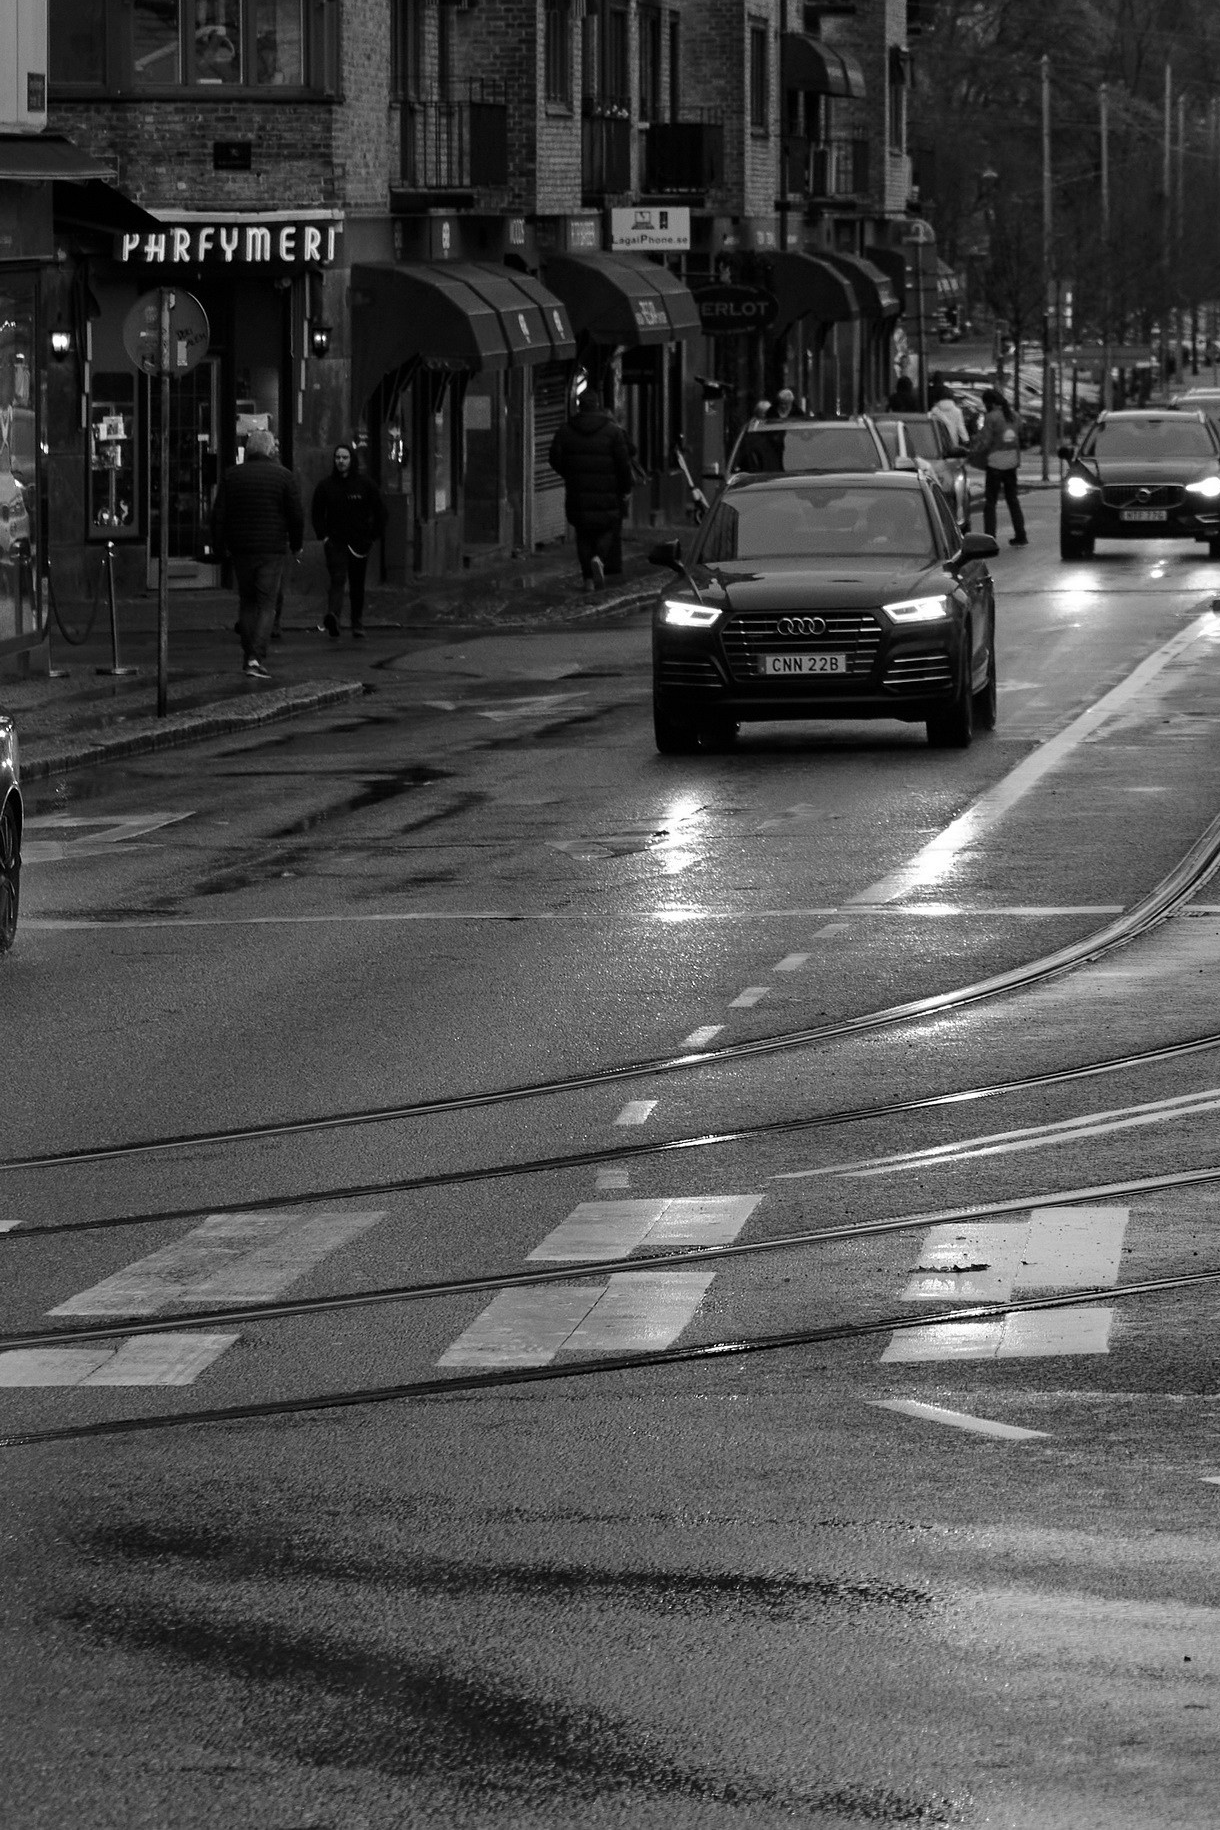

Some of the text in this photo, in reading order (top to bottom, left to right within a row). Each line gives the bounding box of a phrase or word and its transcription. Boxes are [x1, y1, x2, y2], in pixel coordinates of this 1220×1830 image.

[121, 226, 335, 263] PARFYMERI
[699, 301, 769, 317] ERLOT
[772, 657, 839, 672] CNN 22B
